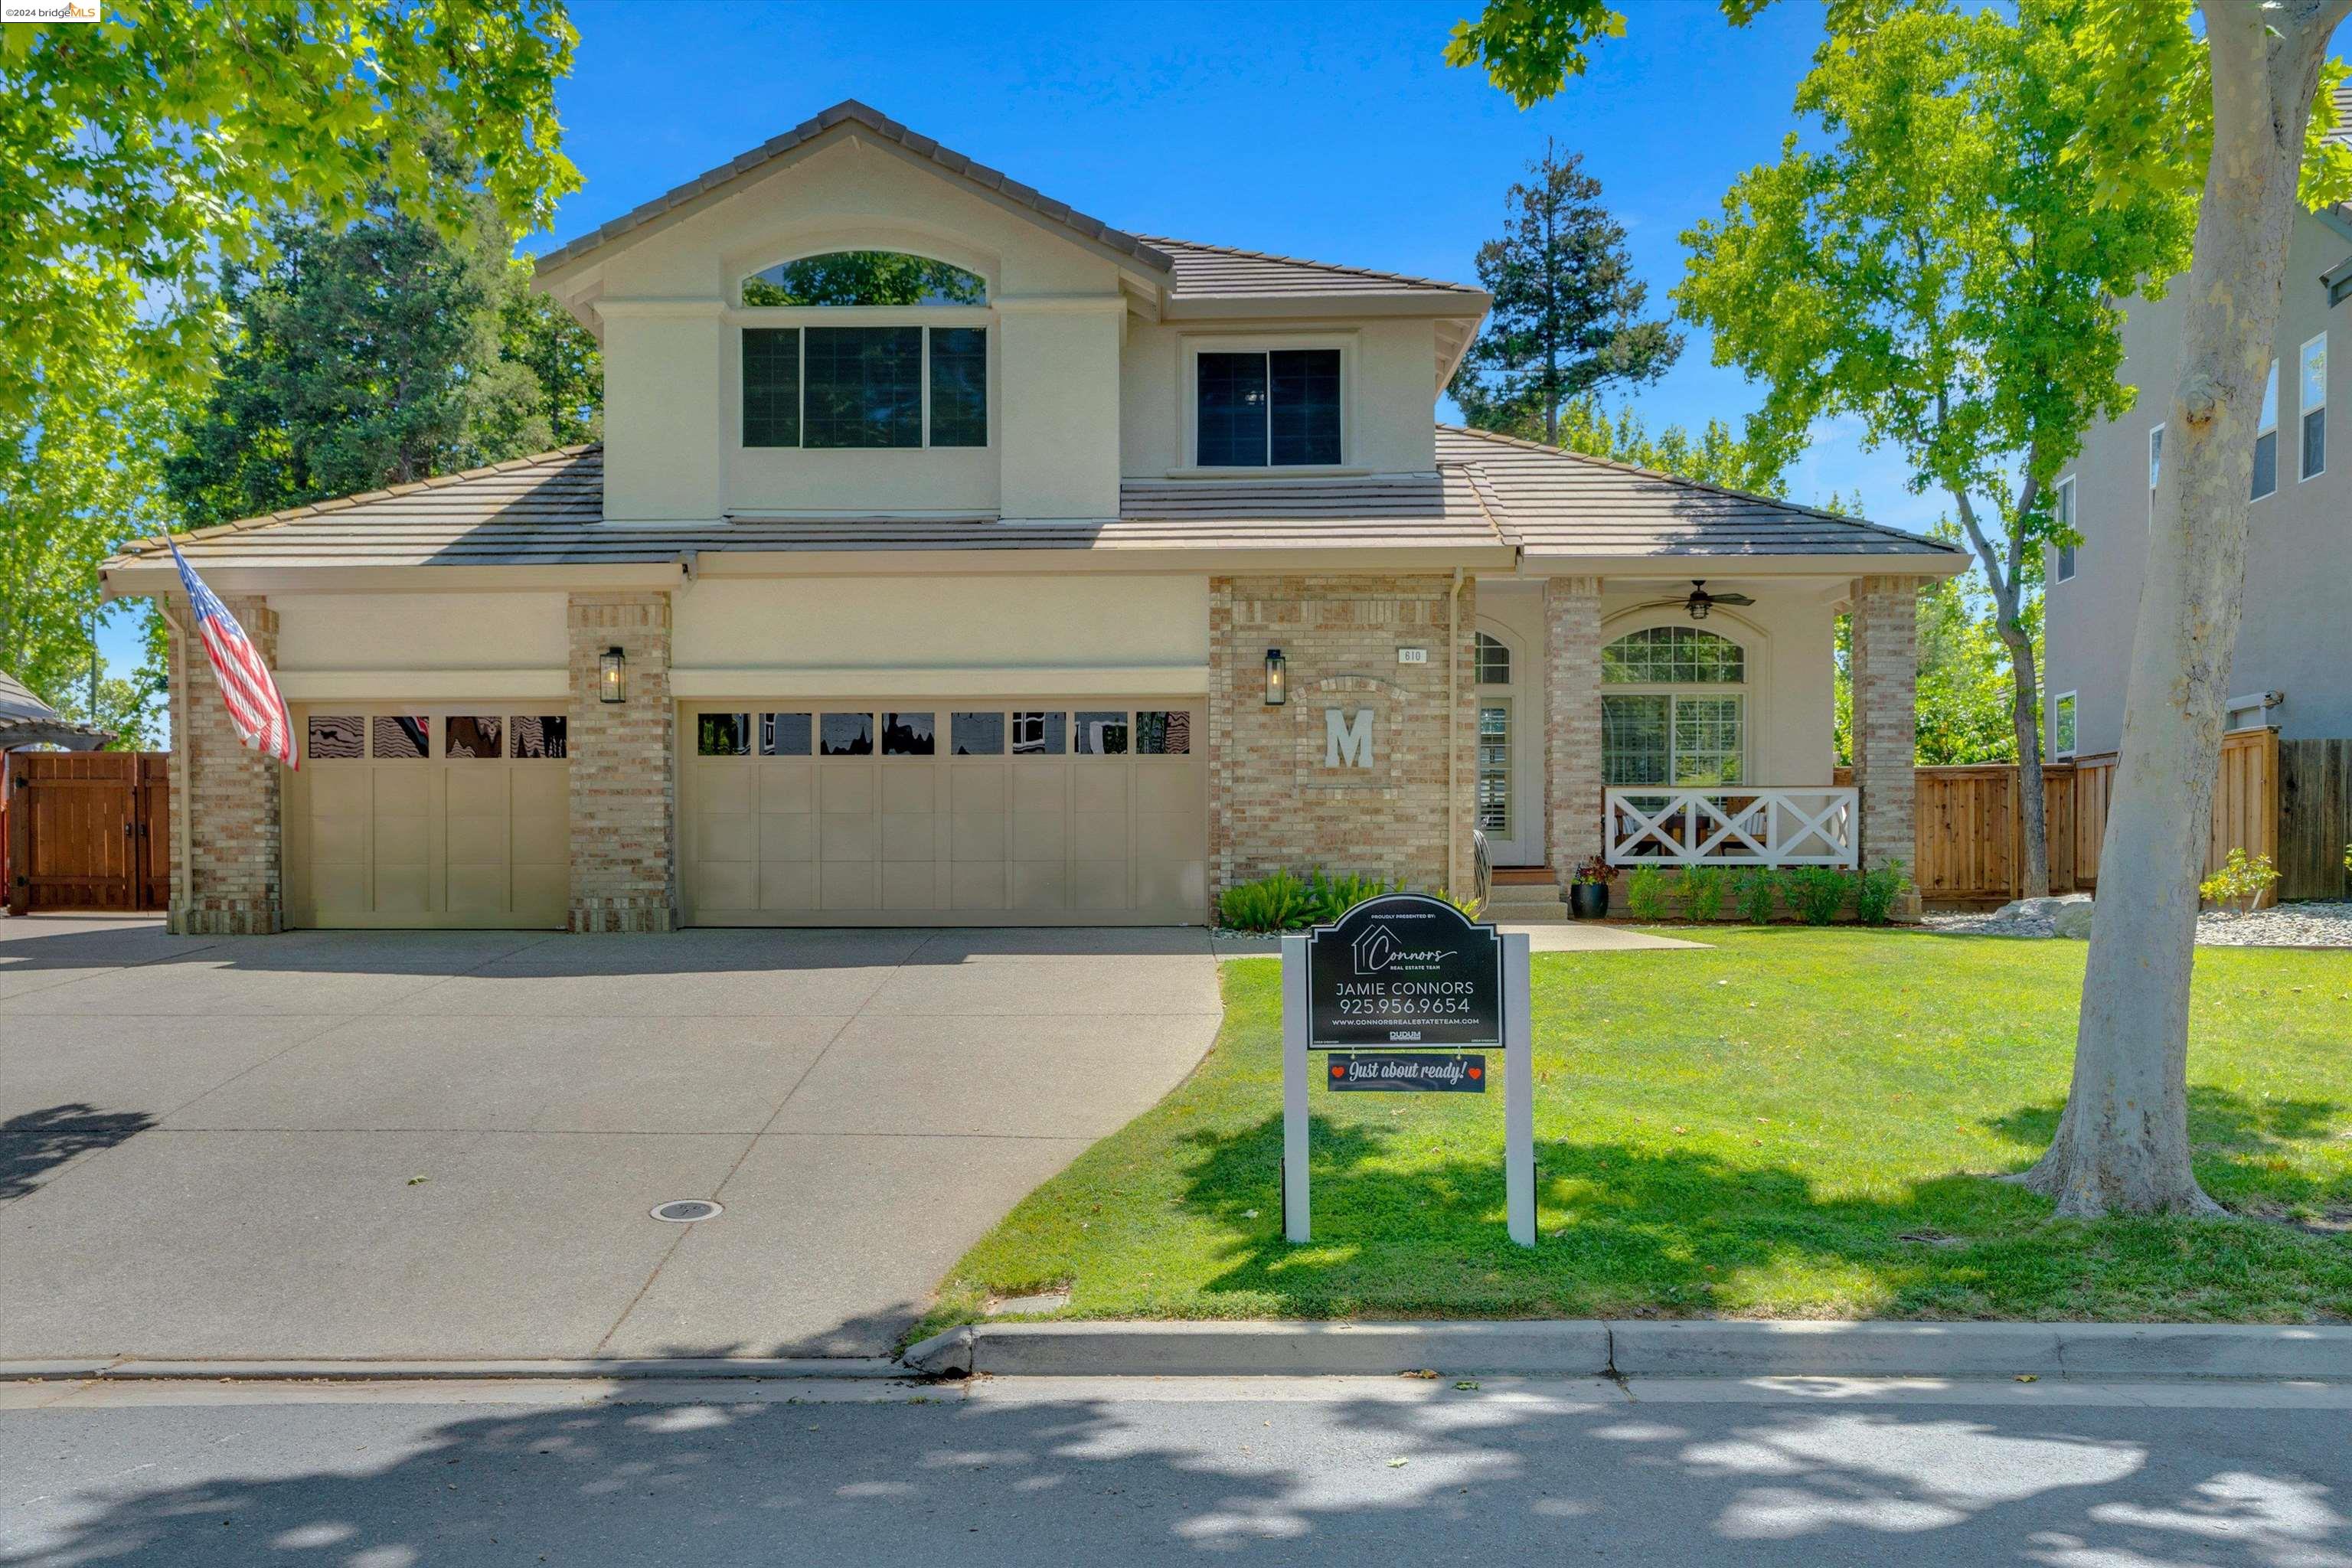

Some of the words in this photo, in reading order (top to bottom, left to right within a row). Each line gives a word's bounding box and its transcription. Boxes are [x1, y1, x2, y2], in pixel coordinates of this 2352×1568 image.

[1325, 709, 1375, 768] M
[1369, 936, 1458, 970] Connors
[1336, 983, 1385, 996] JAMIE
[1391, 982, 1474, 995] CONNORS
[1340, 998, 1470, 1014] 925.956.9654
[1349, 1061, 1379, 1081] Just
[1380, 1061, 1419, 1079] about
[1420, 1061, 1468, 1084] ready!
